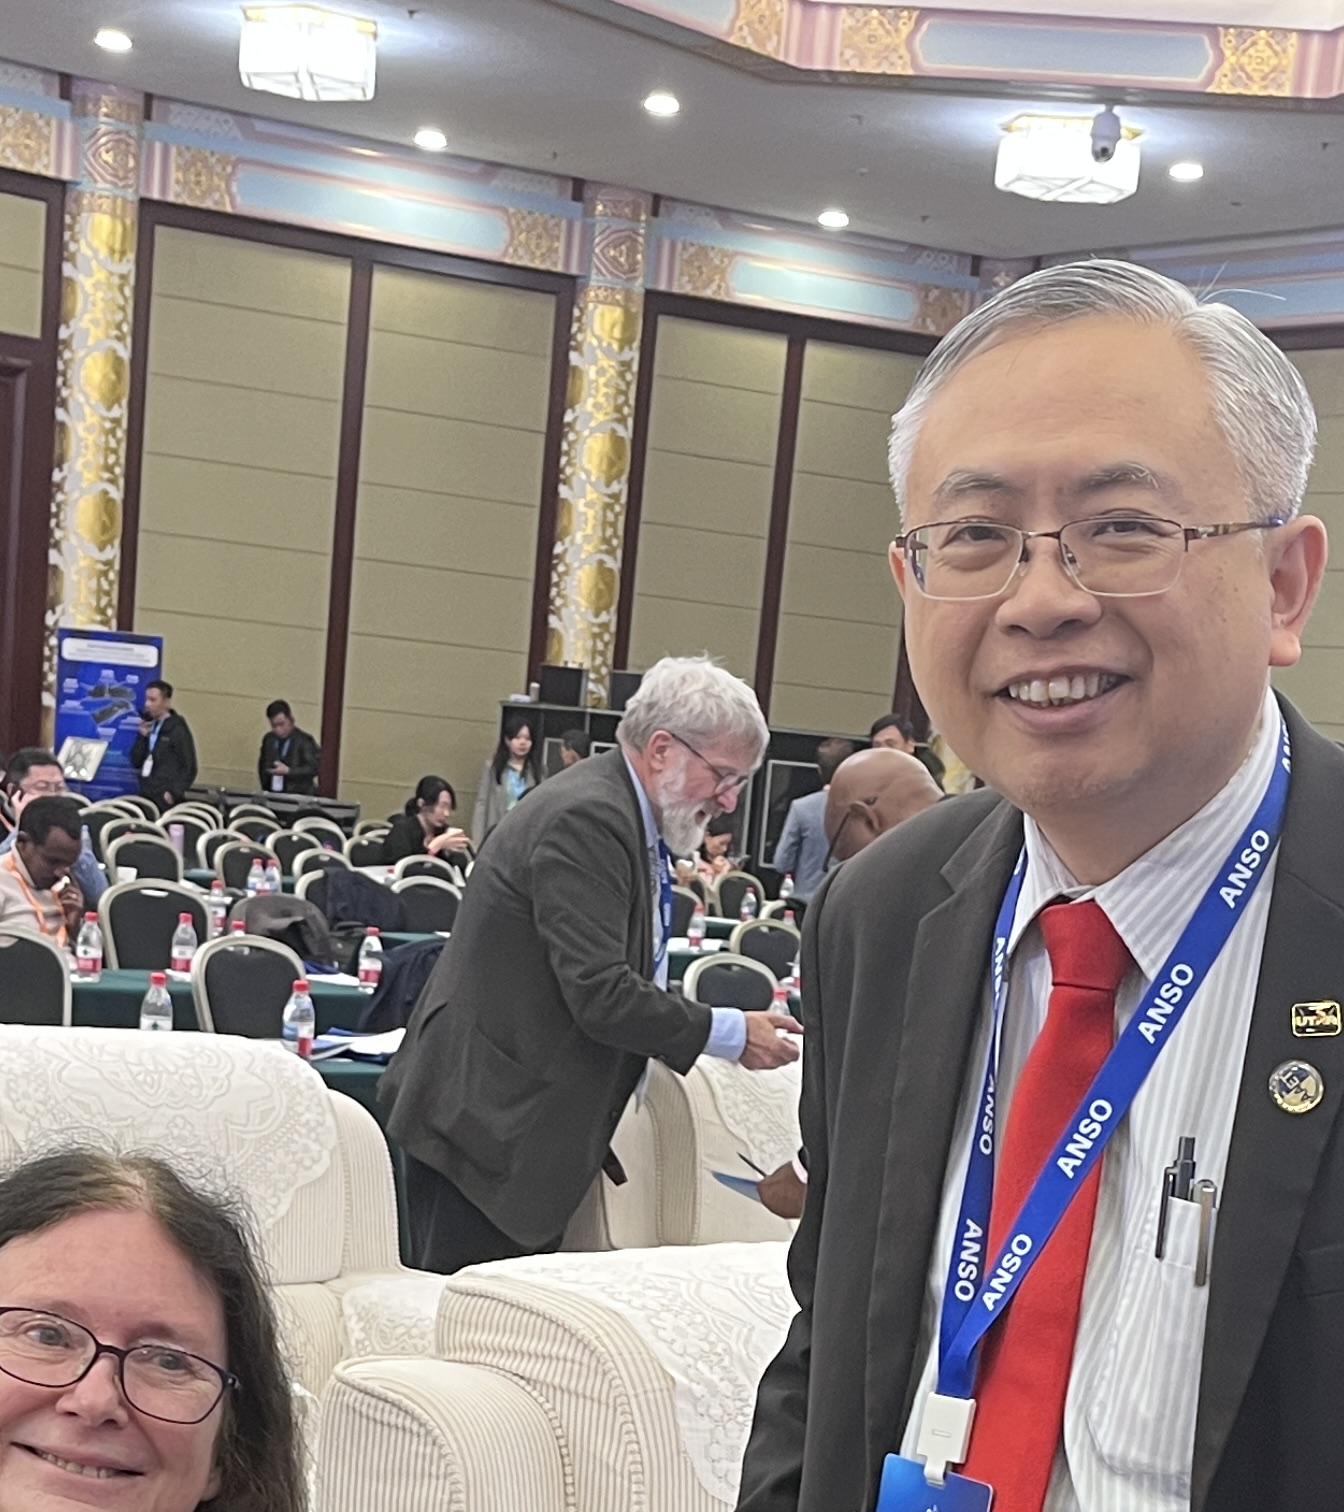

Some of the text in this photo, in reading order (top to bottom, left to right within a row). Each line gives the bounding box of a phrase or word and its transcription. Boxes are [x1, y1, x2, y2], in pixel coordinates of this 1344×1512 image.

[1219, 829, 1270, 909] ANSO
[1137, 963, 1194, 1044] ANSO
[979, 1073, 996, 1155] ANSO
[1056, 1099, 1113, 1179] ANSO
[954, 1218, 984, 1302] ANSO
[982, 1233, 1033, 1311] ANSO
